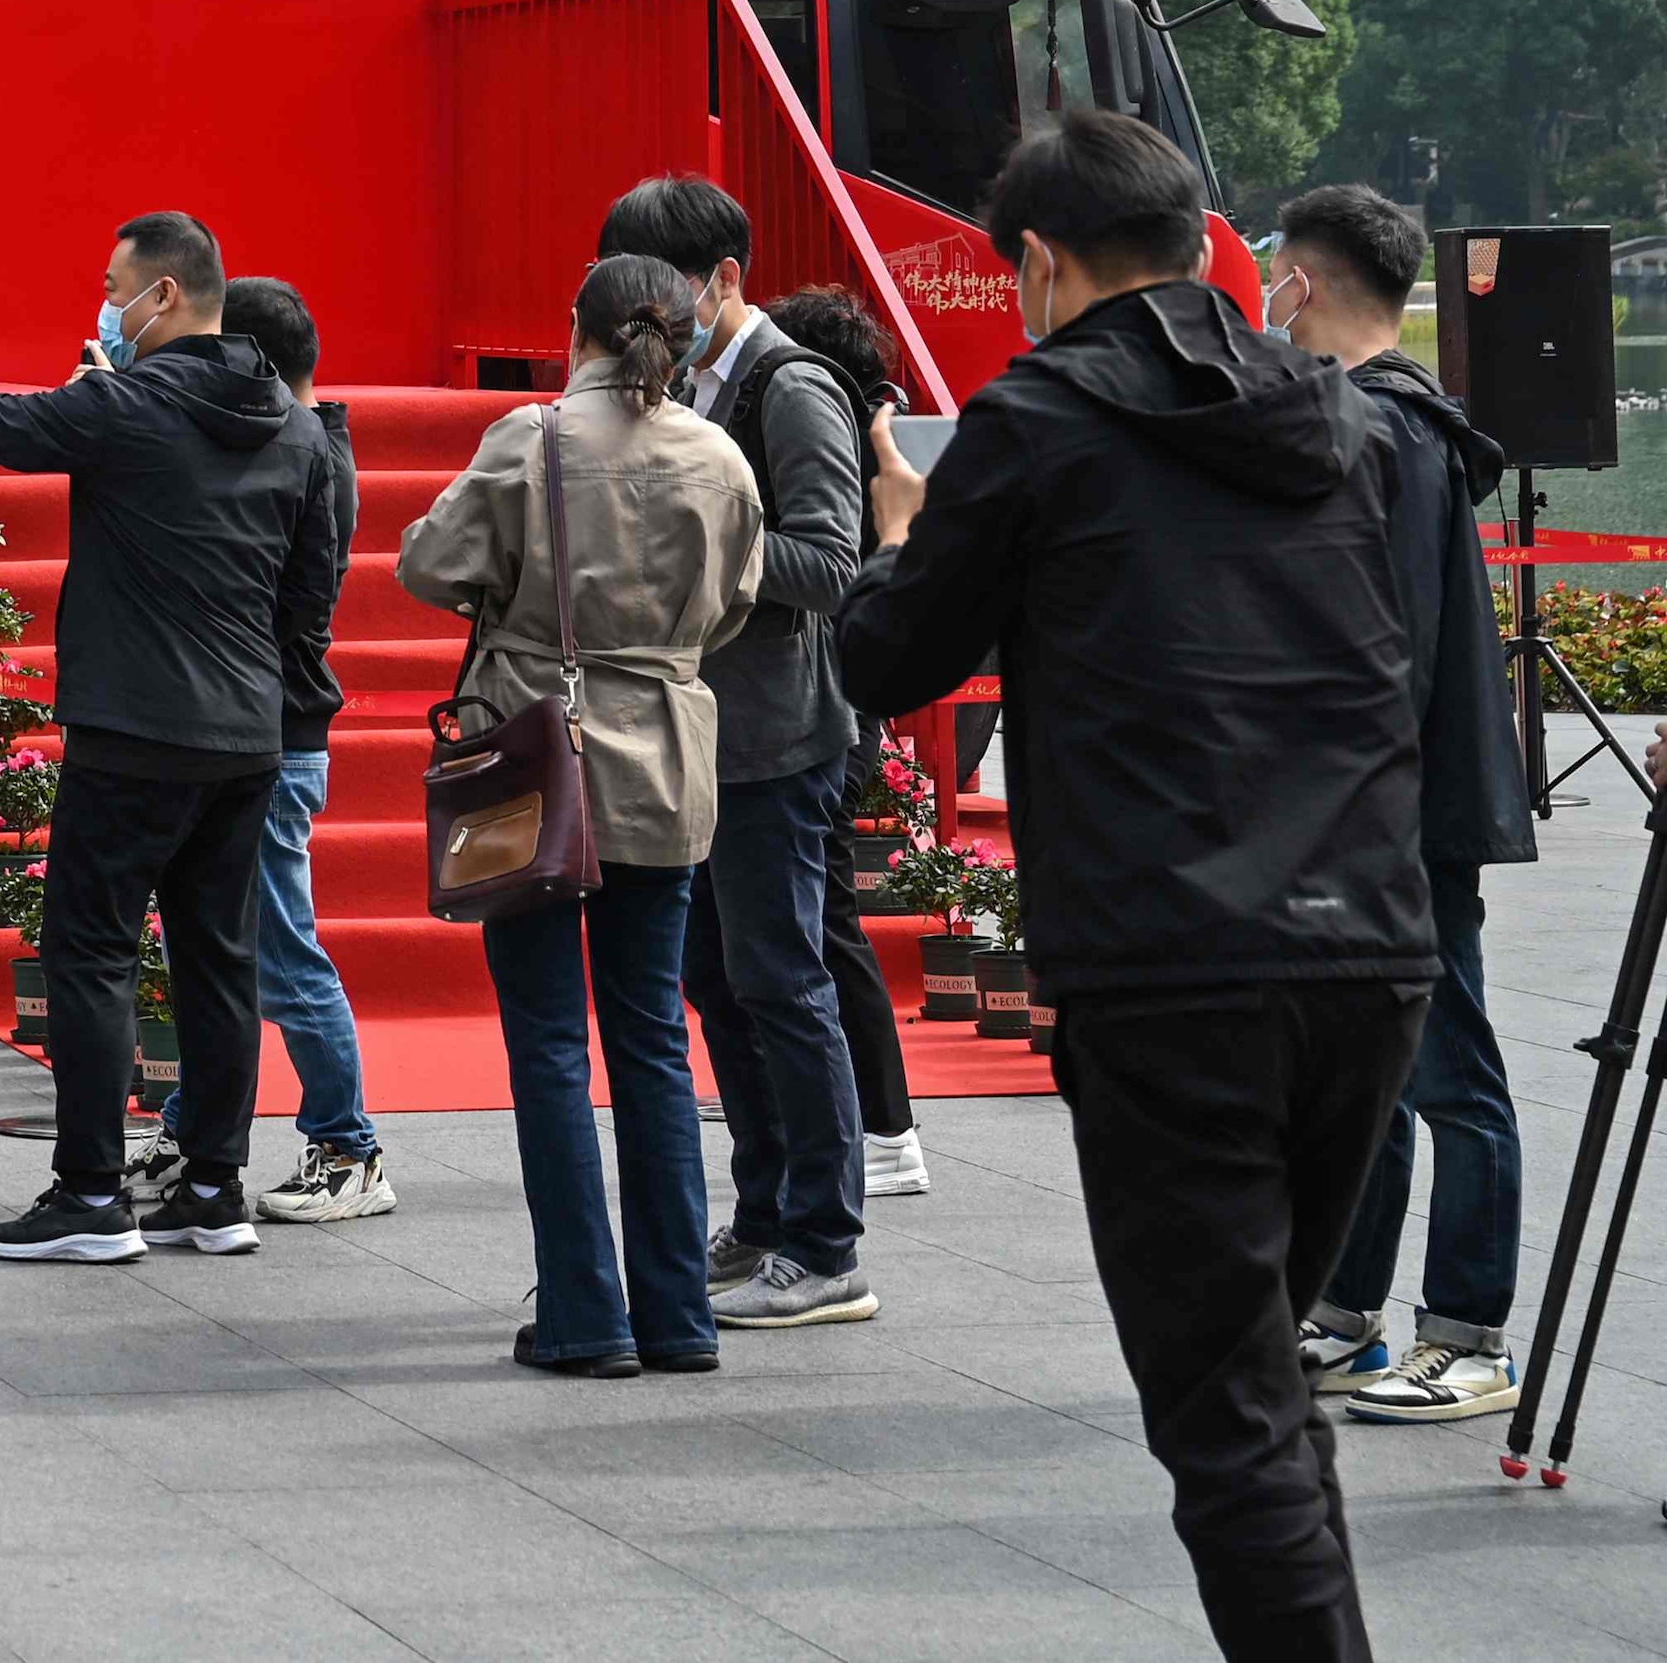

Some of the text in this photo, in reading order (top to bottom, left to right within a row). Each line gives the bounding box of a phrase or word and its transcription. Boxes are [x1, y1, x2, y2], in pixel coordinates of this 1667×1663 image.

[925, 289, 1008, 316] 伟大时代
[929, 979, 974, 991] ECOLOGY
